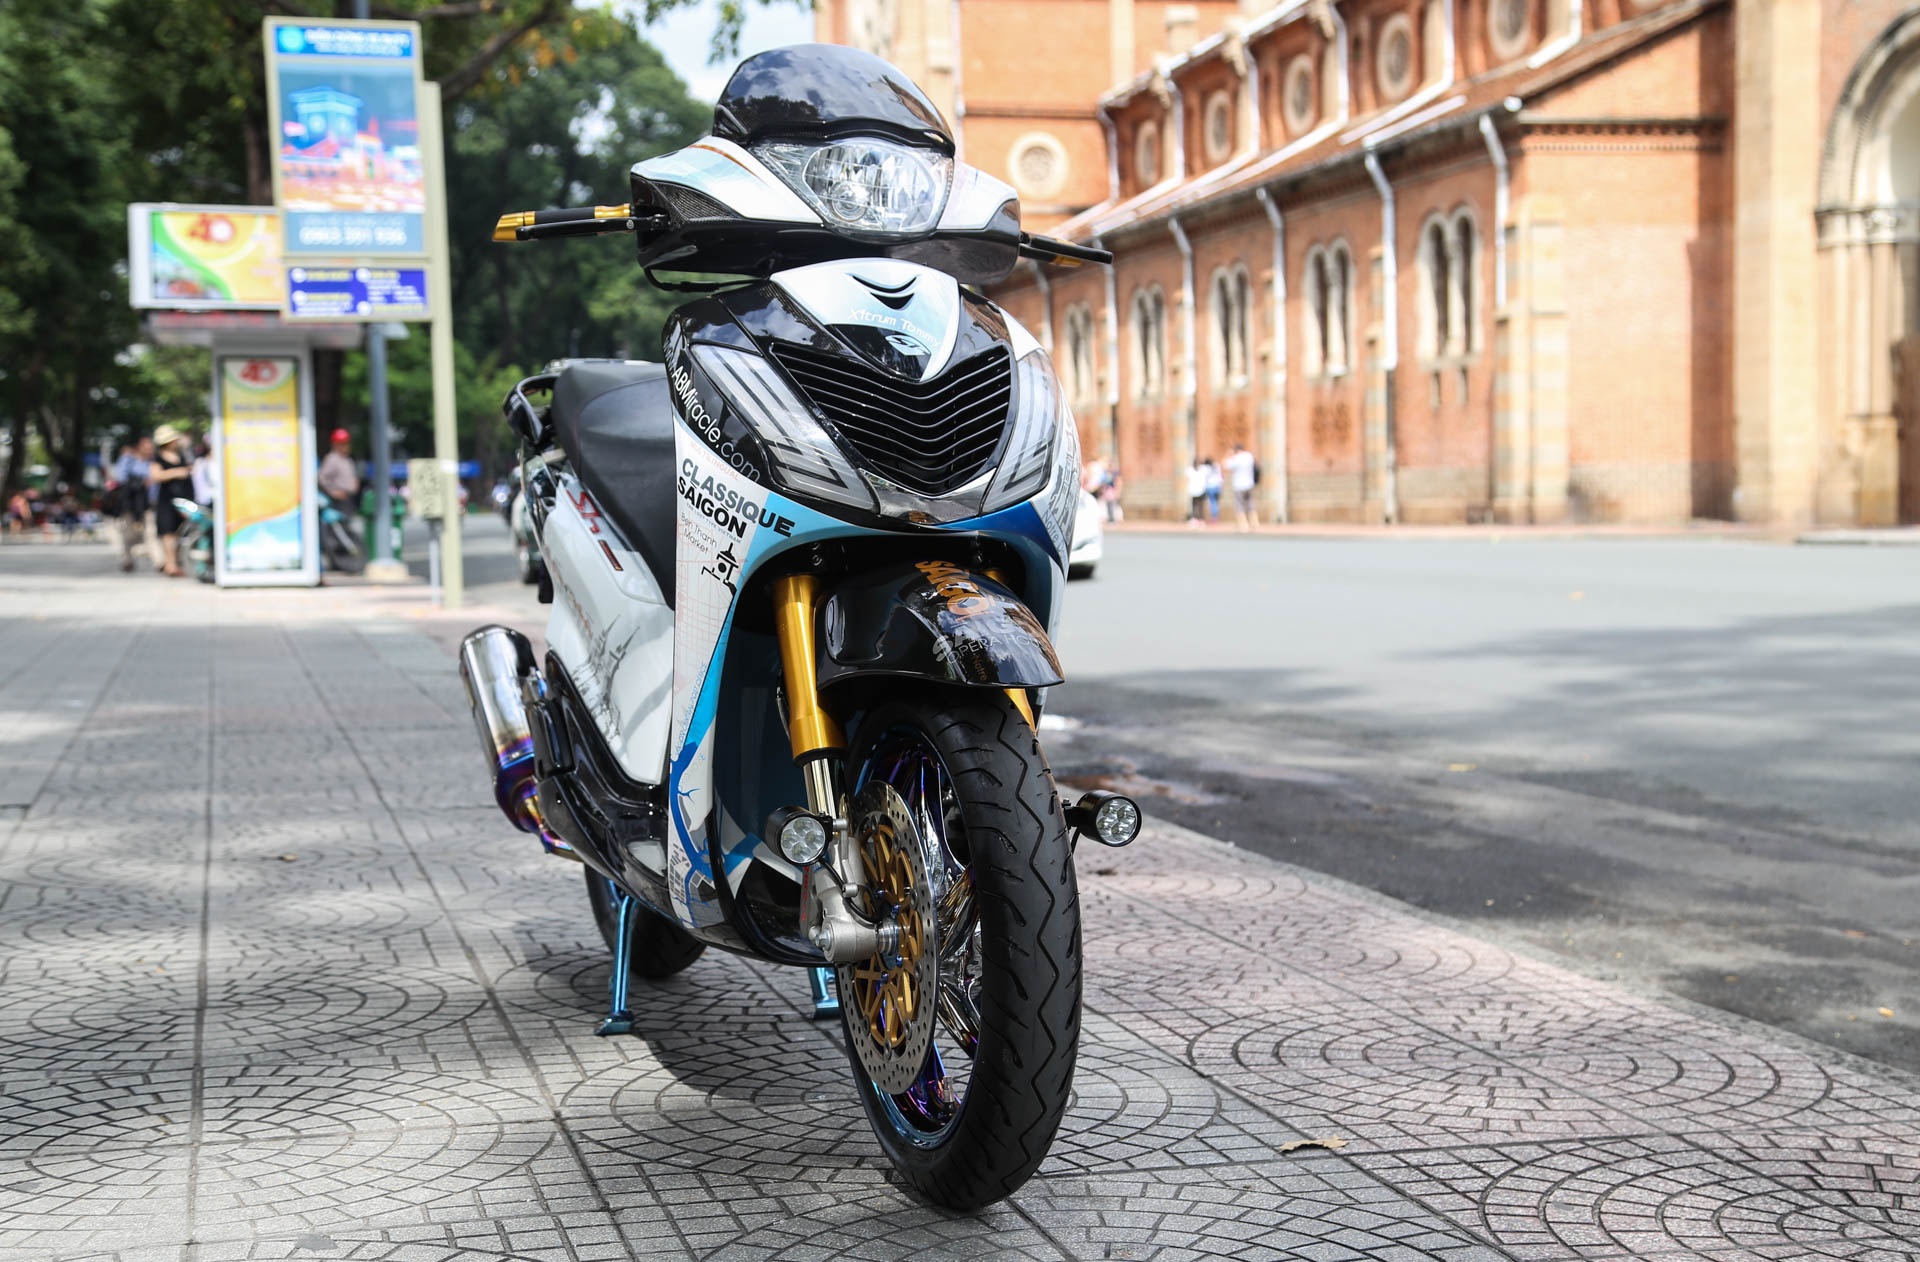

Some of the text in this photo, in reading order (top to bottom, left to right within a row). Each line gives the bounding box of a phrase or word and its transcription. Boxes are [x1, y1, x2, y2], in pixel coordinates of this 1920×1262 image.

[683, 458, 795, 538] CLASSIQUE
[684, 529, 708, 554] Market
[946, 635, 1001, 663] OPERA
